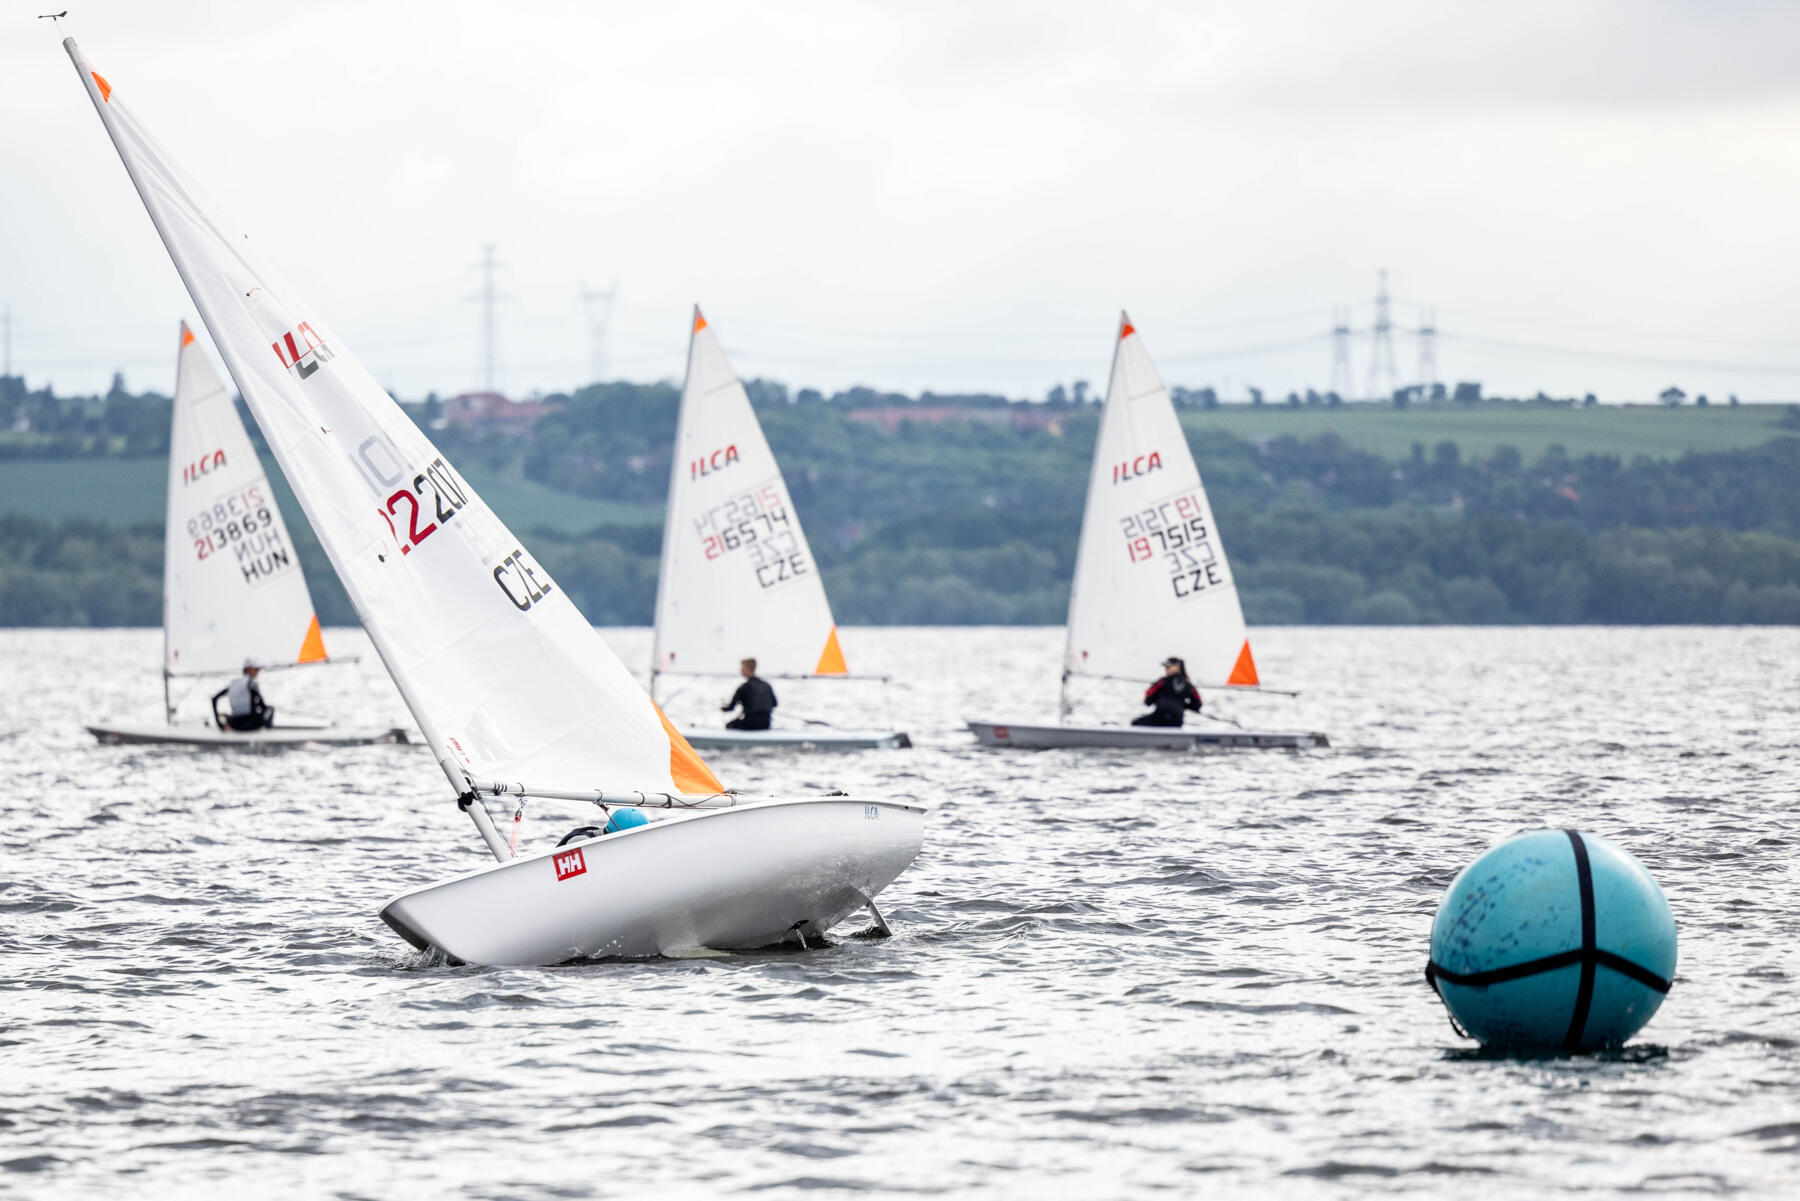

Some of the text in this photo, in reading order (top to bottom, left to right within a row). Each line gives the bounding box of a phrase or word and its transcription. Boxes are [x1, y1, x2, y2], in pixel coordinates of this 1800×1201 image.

[184, 448, 227, 487] ILCA
[691, 445, 740, 481] ILCA
[1113, 452, 1162, 485] ILCA
[194, 507, 272, 561] 213869
[702, 508, 789, 560] 216574
[1128, 517, 1207, 563] 197515
[241, 548, 289, 584] HUN
[494, 549, 552, 611] CZE
[756, 553, 807, 589] CZE
[1172, 562, 1222, 598] CZE
[557, 853, 583, 876] HH
